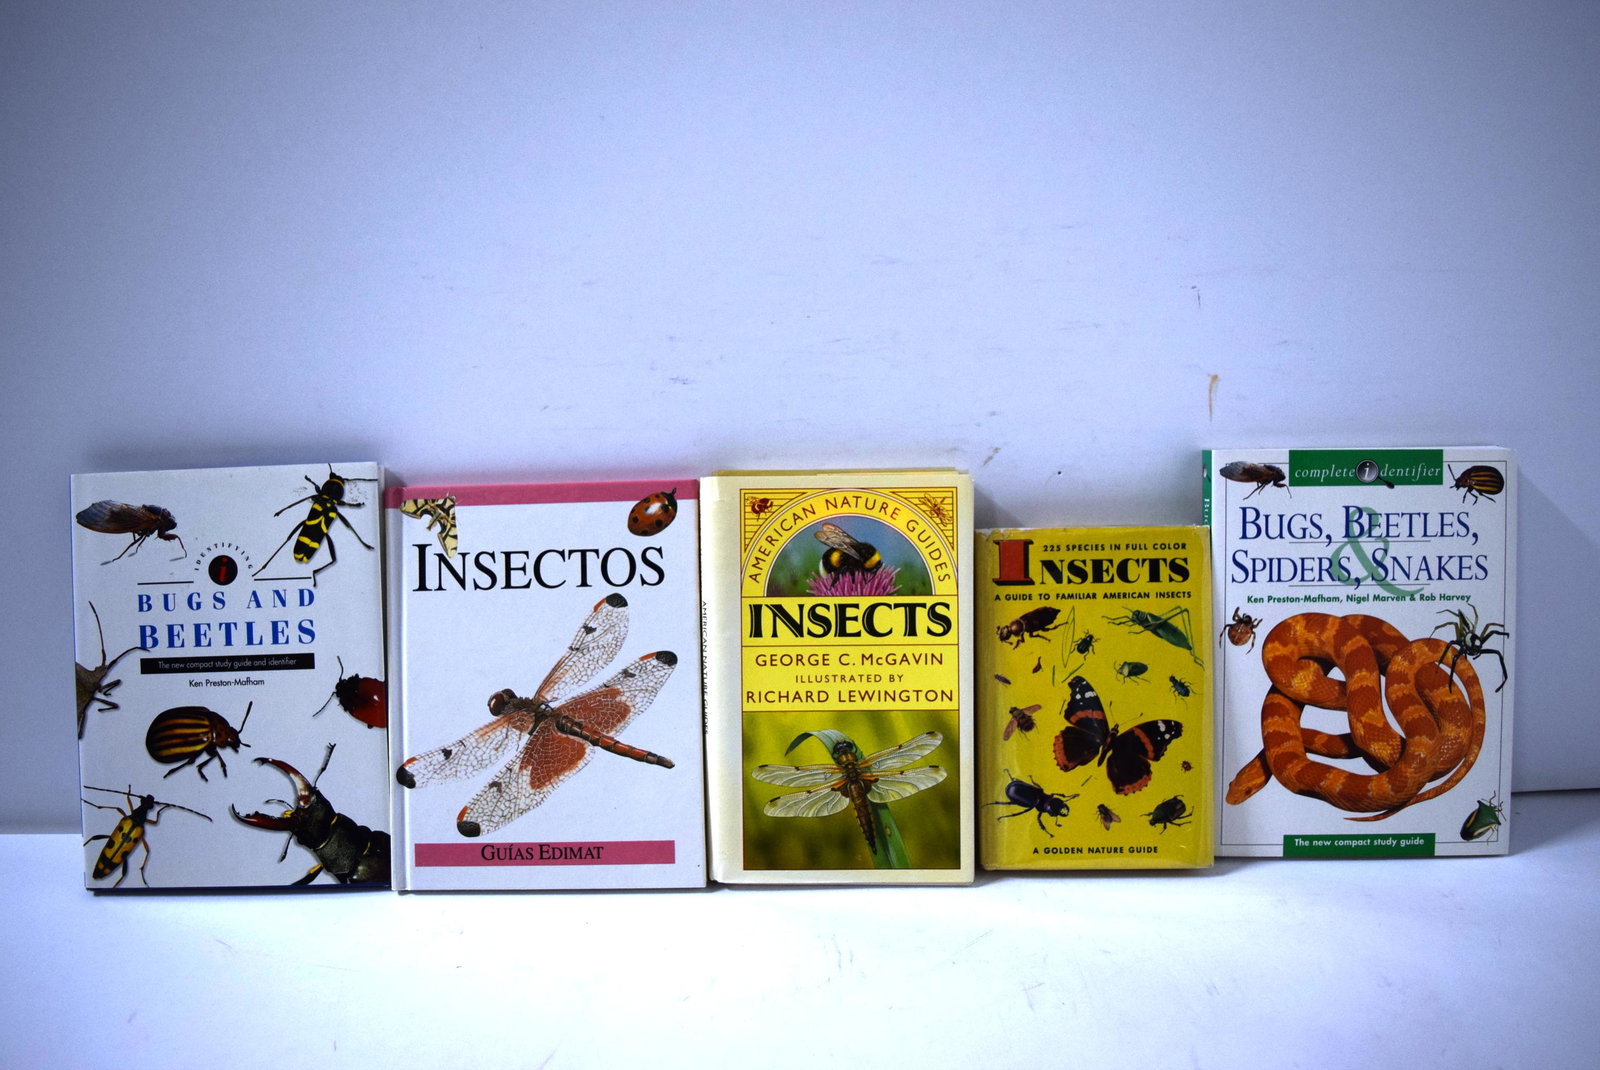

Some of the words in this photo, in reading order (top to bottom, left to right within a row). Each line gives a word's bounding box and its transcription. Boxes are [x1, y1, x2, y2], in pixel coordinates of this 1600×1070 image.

[1294, 464, 1356, 483] complete
[1239, 506, 1333, 547] BUGS,
[1342, 505, 1479, 545] BEETLES,
[749, 503, 816, 583] AMERICAN
[824, 495, 902, 521] NATURE
[906, 519, 951, 583] GUIDES
[1042, 544, 1061, 552] 225
[1065, 543, 1105, 552] SPECIES
[1109, 543, 1121, 551] IN
[1126, 543, 1149, 551] FULL
[1152, 542, 1187, 551] COLOR
[194, 542, 253, 571] IDENTIFYING
[992, 539, 1190, 586] INSECTS
[412, 542, 666, 592] INSECTOS
[1231, 549, 1361, 590] SPIDERS,
[1371, 548, 1489, 582] SNAKES
[137, 591, 226, 613] BUGS
[246, 588, 315, 609] AND
[1005, 593, 1033, 601] GUIDE
[1038, 593, 1051, 601] TO
[1056, 592, 1097, 600] FAMILIAR
[1103, 591, 1150, 600] AMERICAN
[1155, 591, 1192, 599] INSECTS
[1247, 595, 1264, 603] Ken
[1267, 594, 1343, 604] Preston-Mafham,
[1346, 593, 1370, 605] Nigel
[1372, 593, 1406, 602] Marven
[1409, 593, 1416, 602] &
[1419, 593, 1436, 602] Rob
[1439, 592, 1471, 603] Harvey
[748, 602, 953, 638] INSECTS
[138, 619, 316, 650] BEETLES
[158, 660, 170, 669] The
[186, 660, 214, 671] compact
[215, 660, 232, 670] study
[233, 658, 252, 670] guide
[253, 658, 267, 667] and
[268, 656, 297, 666] identifier
[755, 653, 830, 667] GEORGE
[838, 653, 856, 667] C.
[861, 652, 944, 666] McGAVIN
[189, 679, 203, 688] Ken
[205, 677, 265, 687] Preston-Mafham
[795, 674, 882, 684] ILLUSTRATED
[889, 674, 904, 683] BY
[746, 690, 829, 704] RICHARD
[838, 689, 954, 703] LEWINGTON
[1043, 847, 1083, 855] GOLDEN
[1087, 846, 1124, 854] NATURE
[1294, 838, 1310, 846] The
[1334, 838, 1371, 848] compact
[1373, 838, 1398, 848] study
[1400, 836, 1425, 847] guide
[481, 844, 534, 862] GUÍAS
[538, 843, 604, 861] EDIMAT
